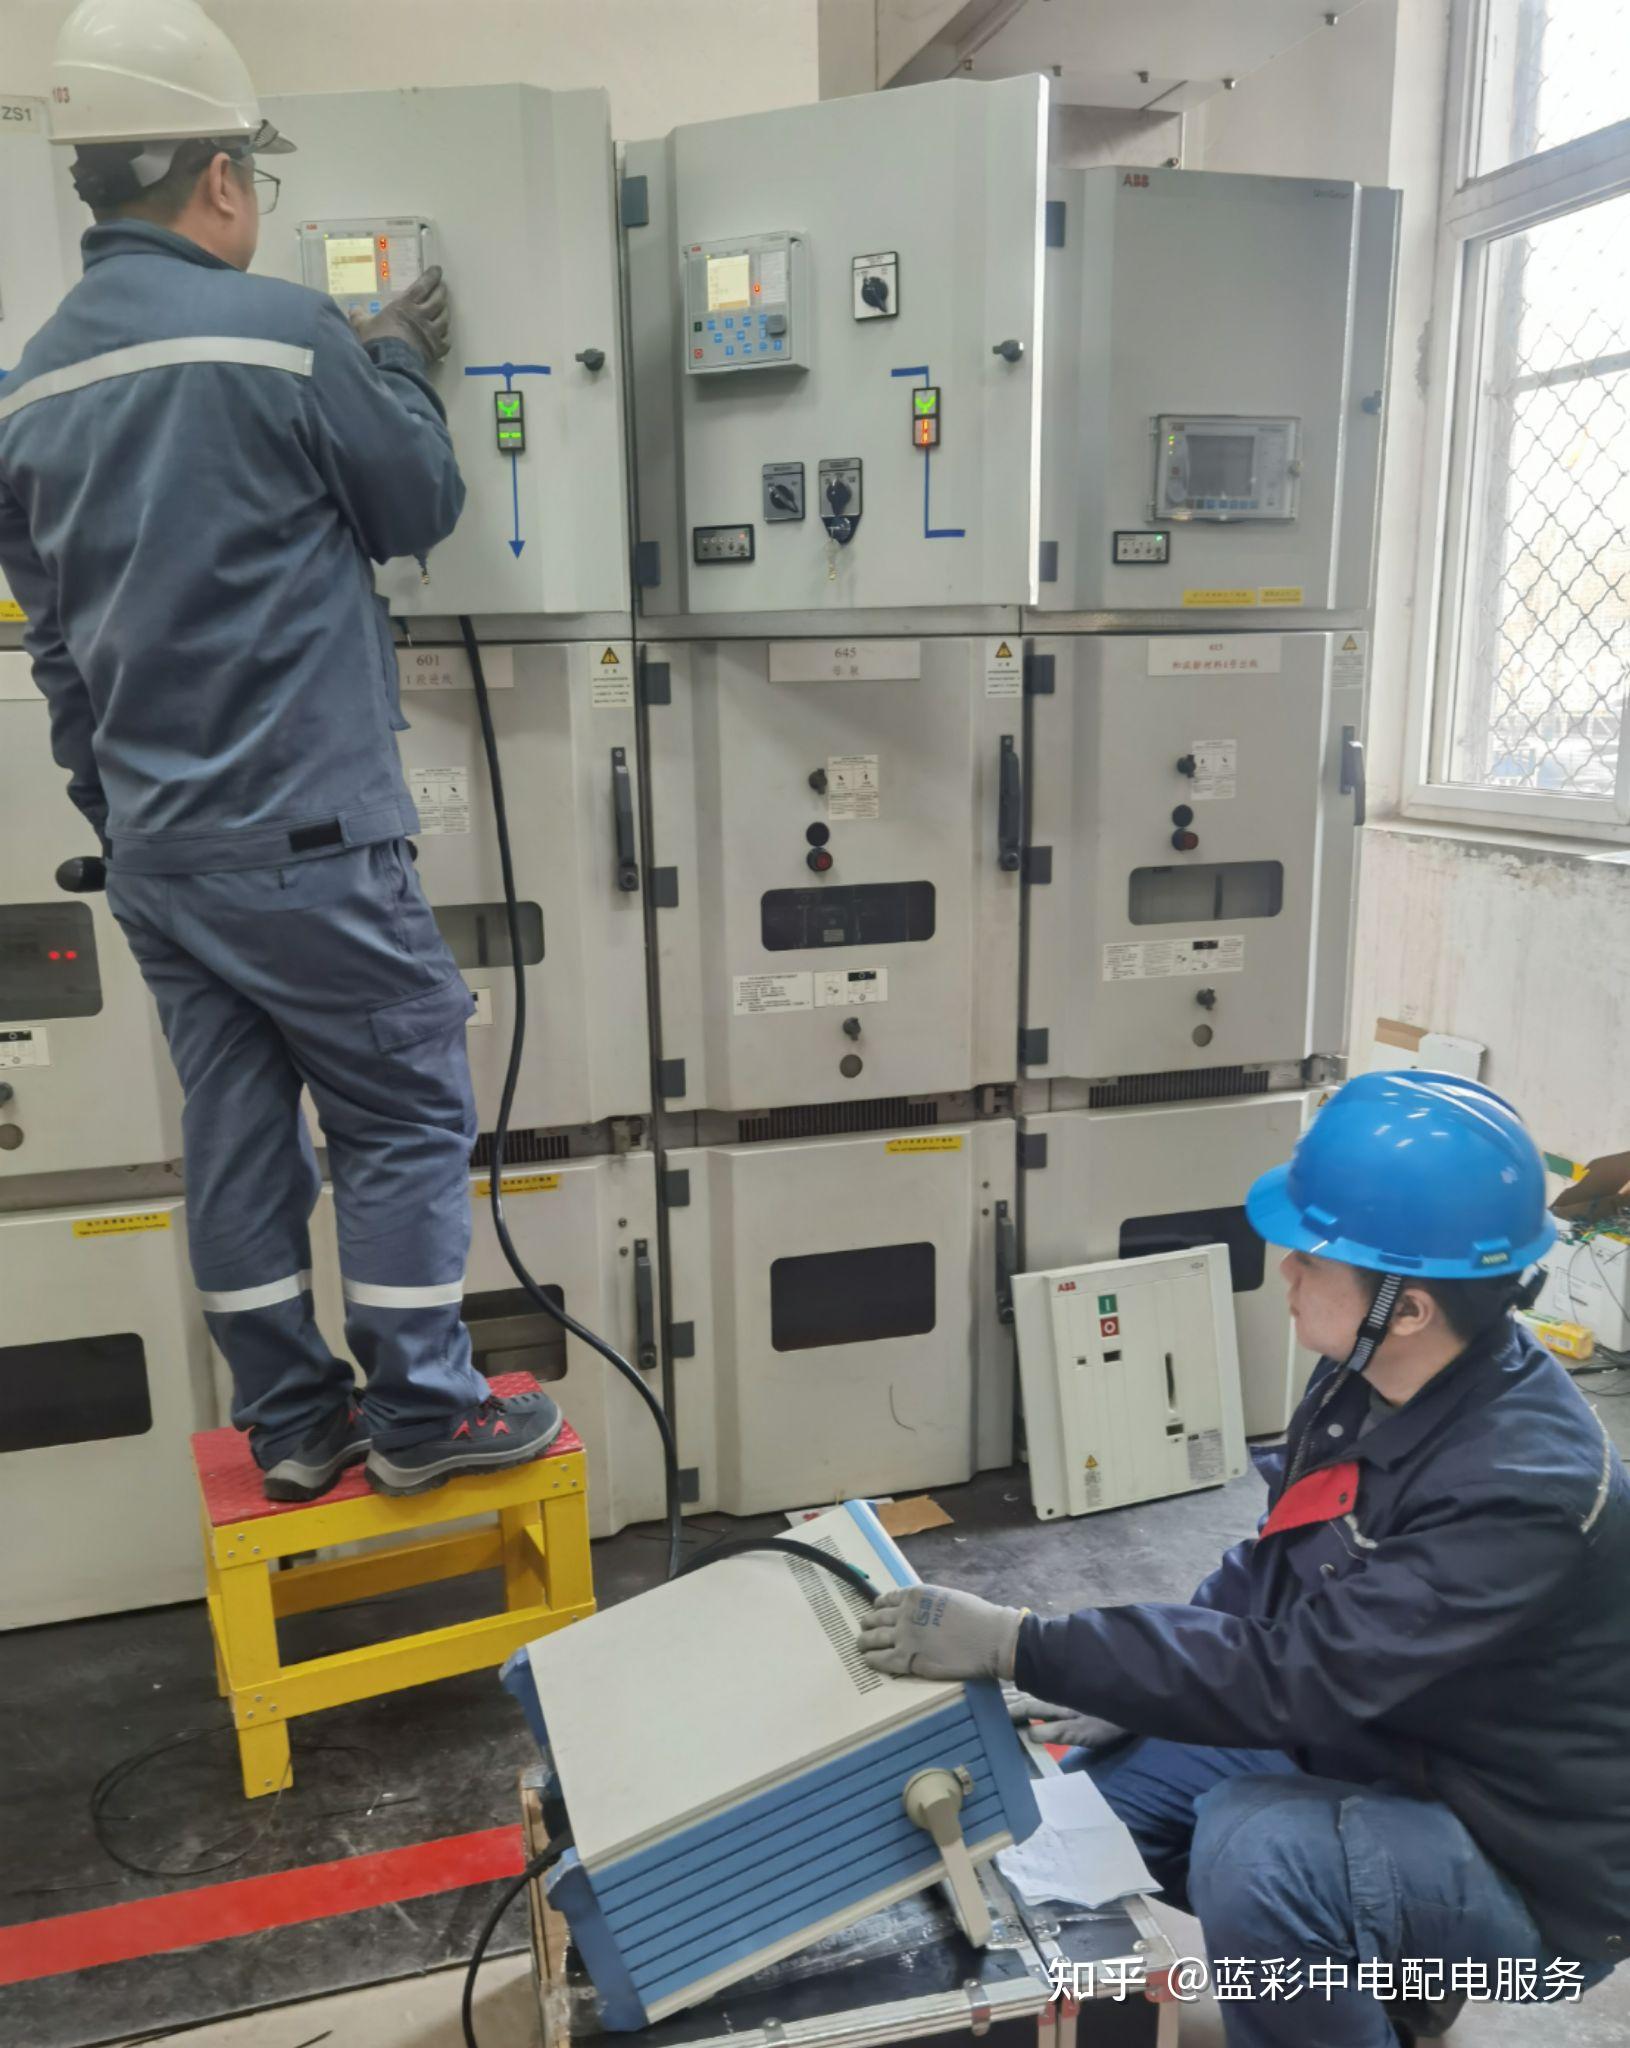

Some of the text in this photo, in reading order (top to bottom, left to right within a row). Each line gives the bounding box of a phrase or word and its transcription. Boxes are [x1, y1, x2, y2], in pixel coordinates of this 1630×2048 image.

[1, 106, 32, 122] ZS1
[1123, 173, 1150, 188] ABB
[834, 647, 857, 658] 645
[416, 655, 440, 667] 601
[1057, 1281, 1077, 1292] ABB
